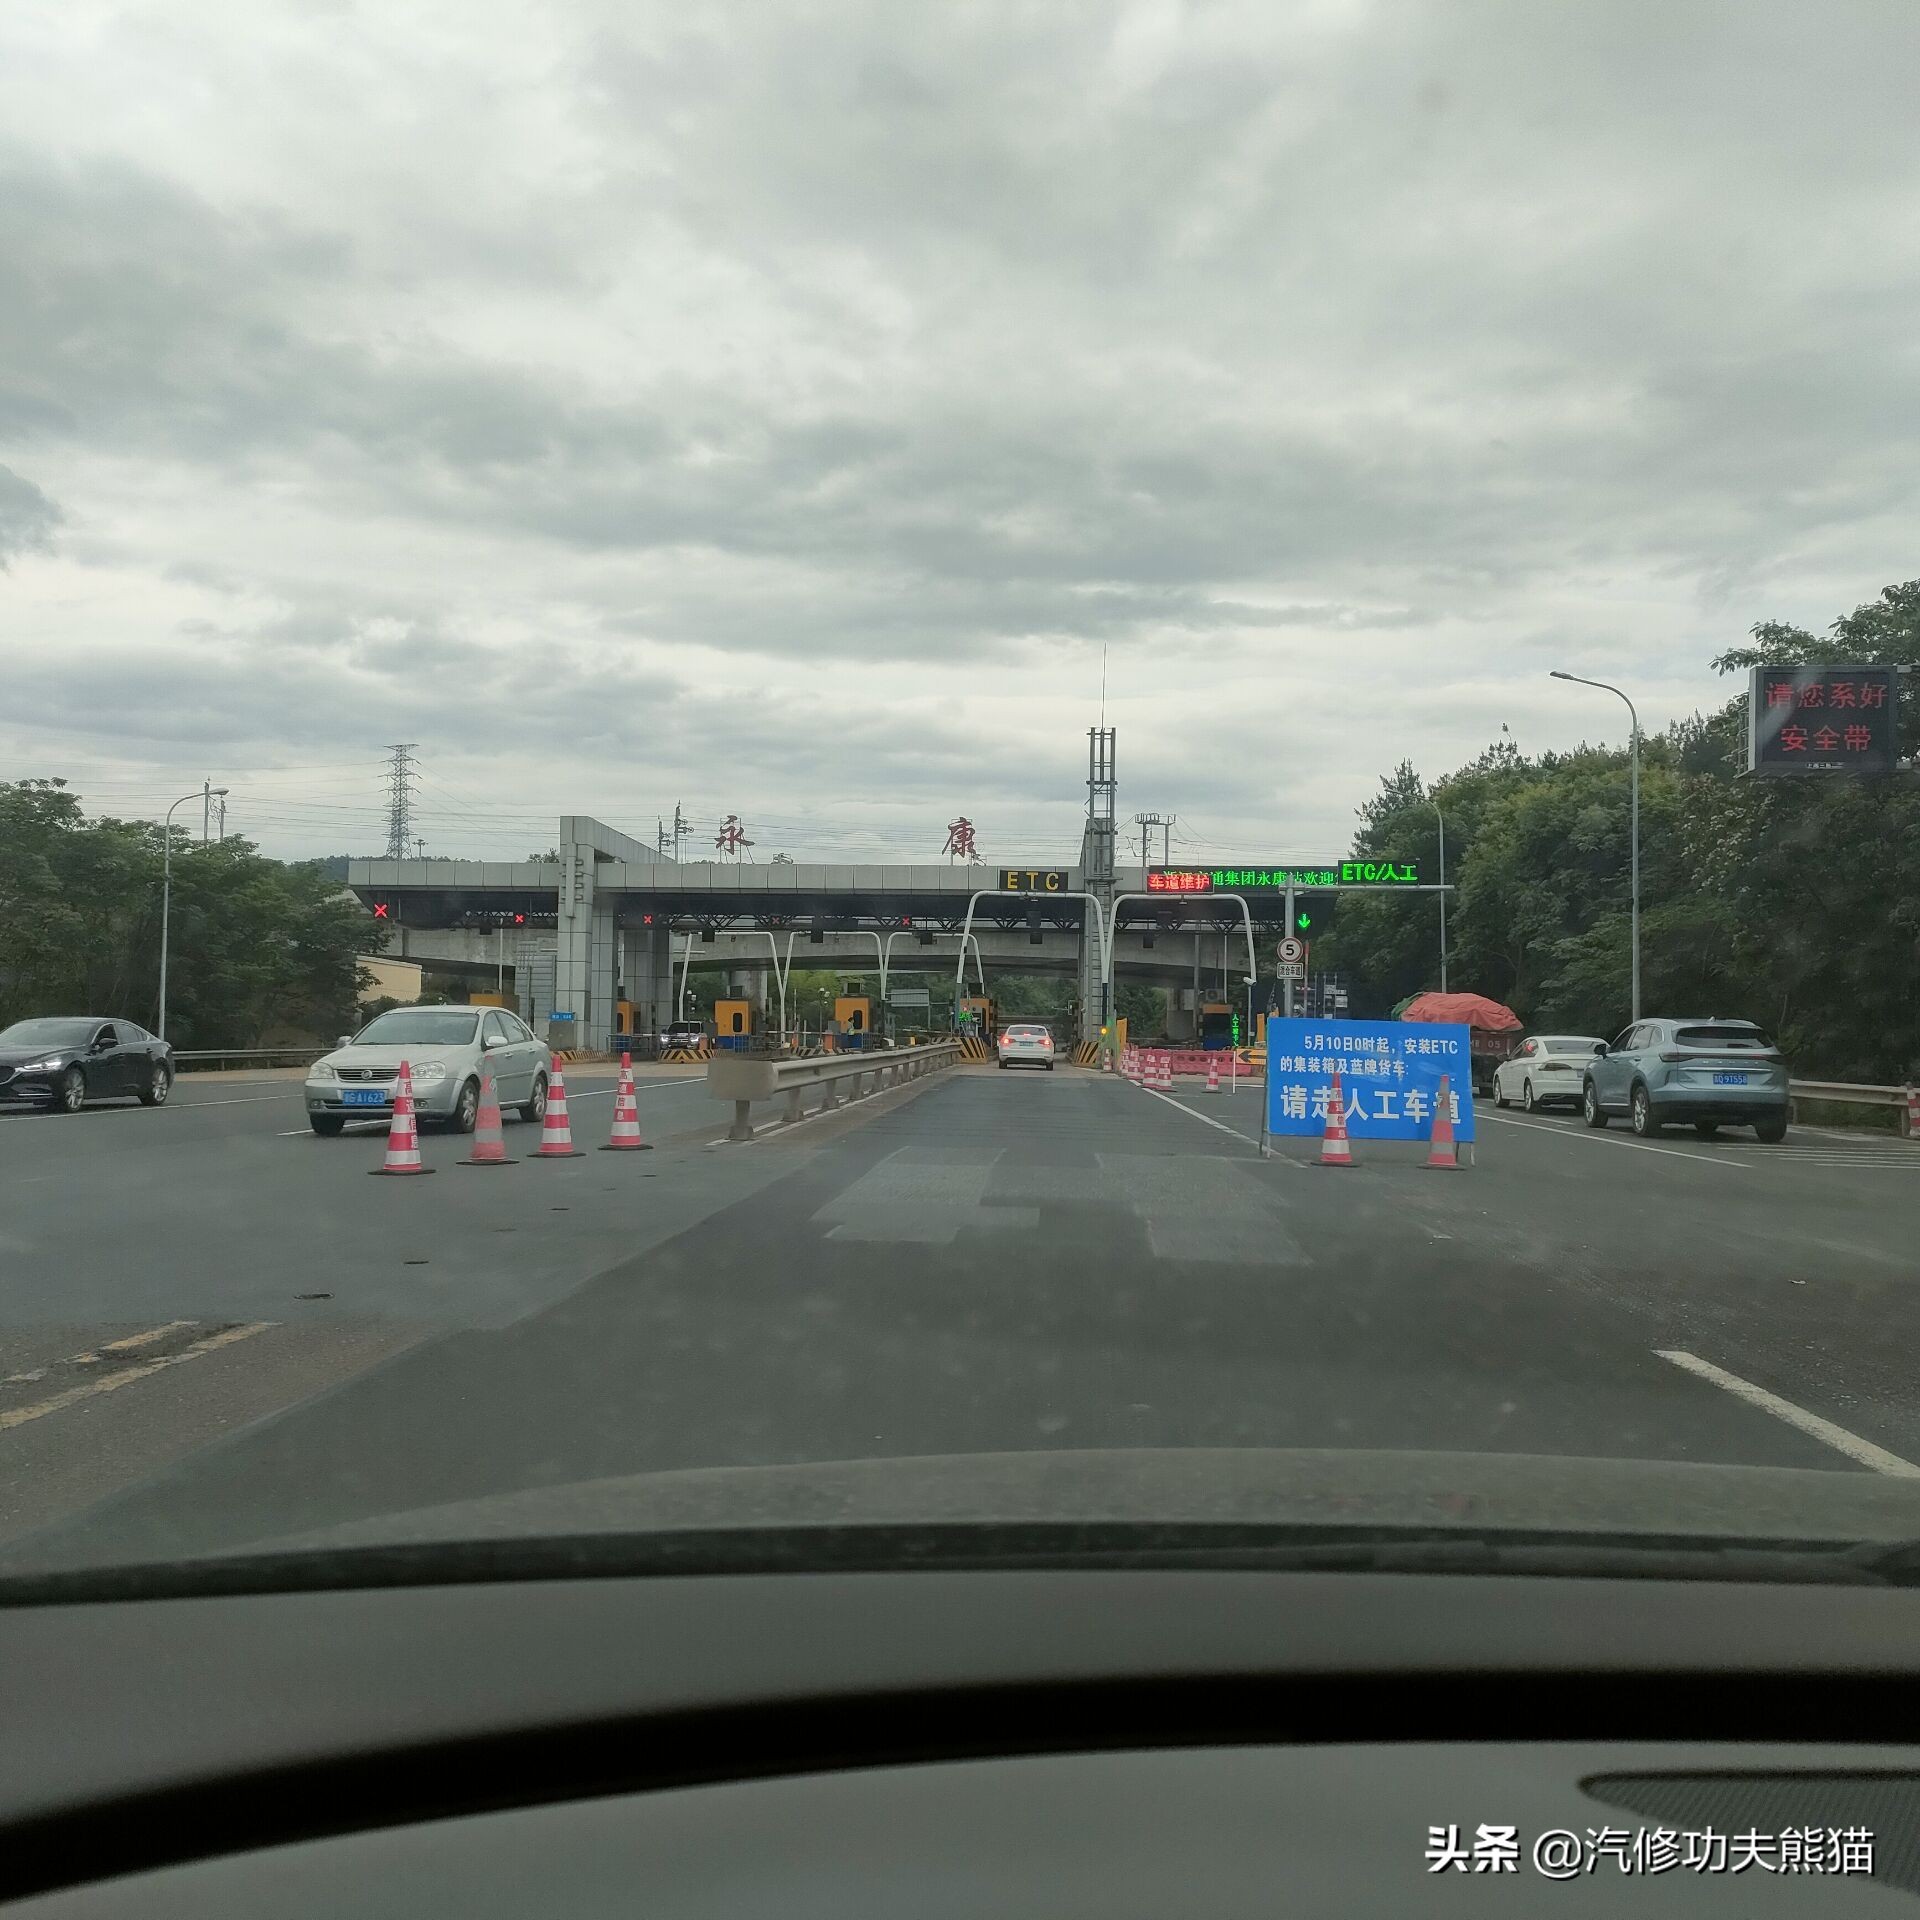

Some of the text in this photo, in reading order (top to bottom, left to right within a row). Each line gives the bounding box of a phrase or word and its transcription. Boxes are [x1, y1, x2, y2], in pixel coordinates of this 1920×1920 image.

[1766, 682, 1889, 709] 请您系好
[1780, 724, 1872, 751] 安全带
[716, 815, 976, 858] 永 康
[1007, 871, 1060, 891] ETC
[1149, 874, 1210, 890] 车道维护
[1342, 862, 1418, 882] ETC/人工
[1285, 944, 1295, 956] 5
